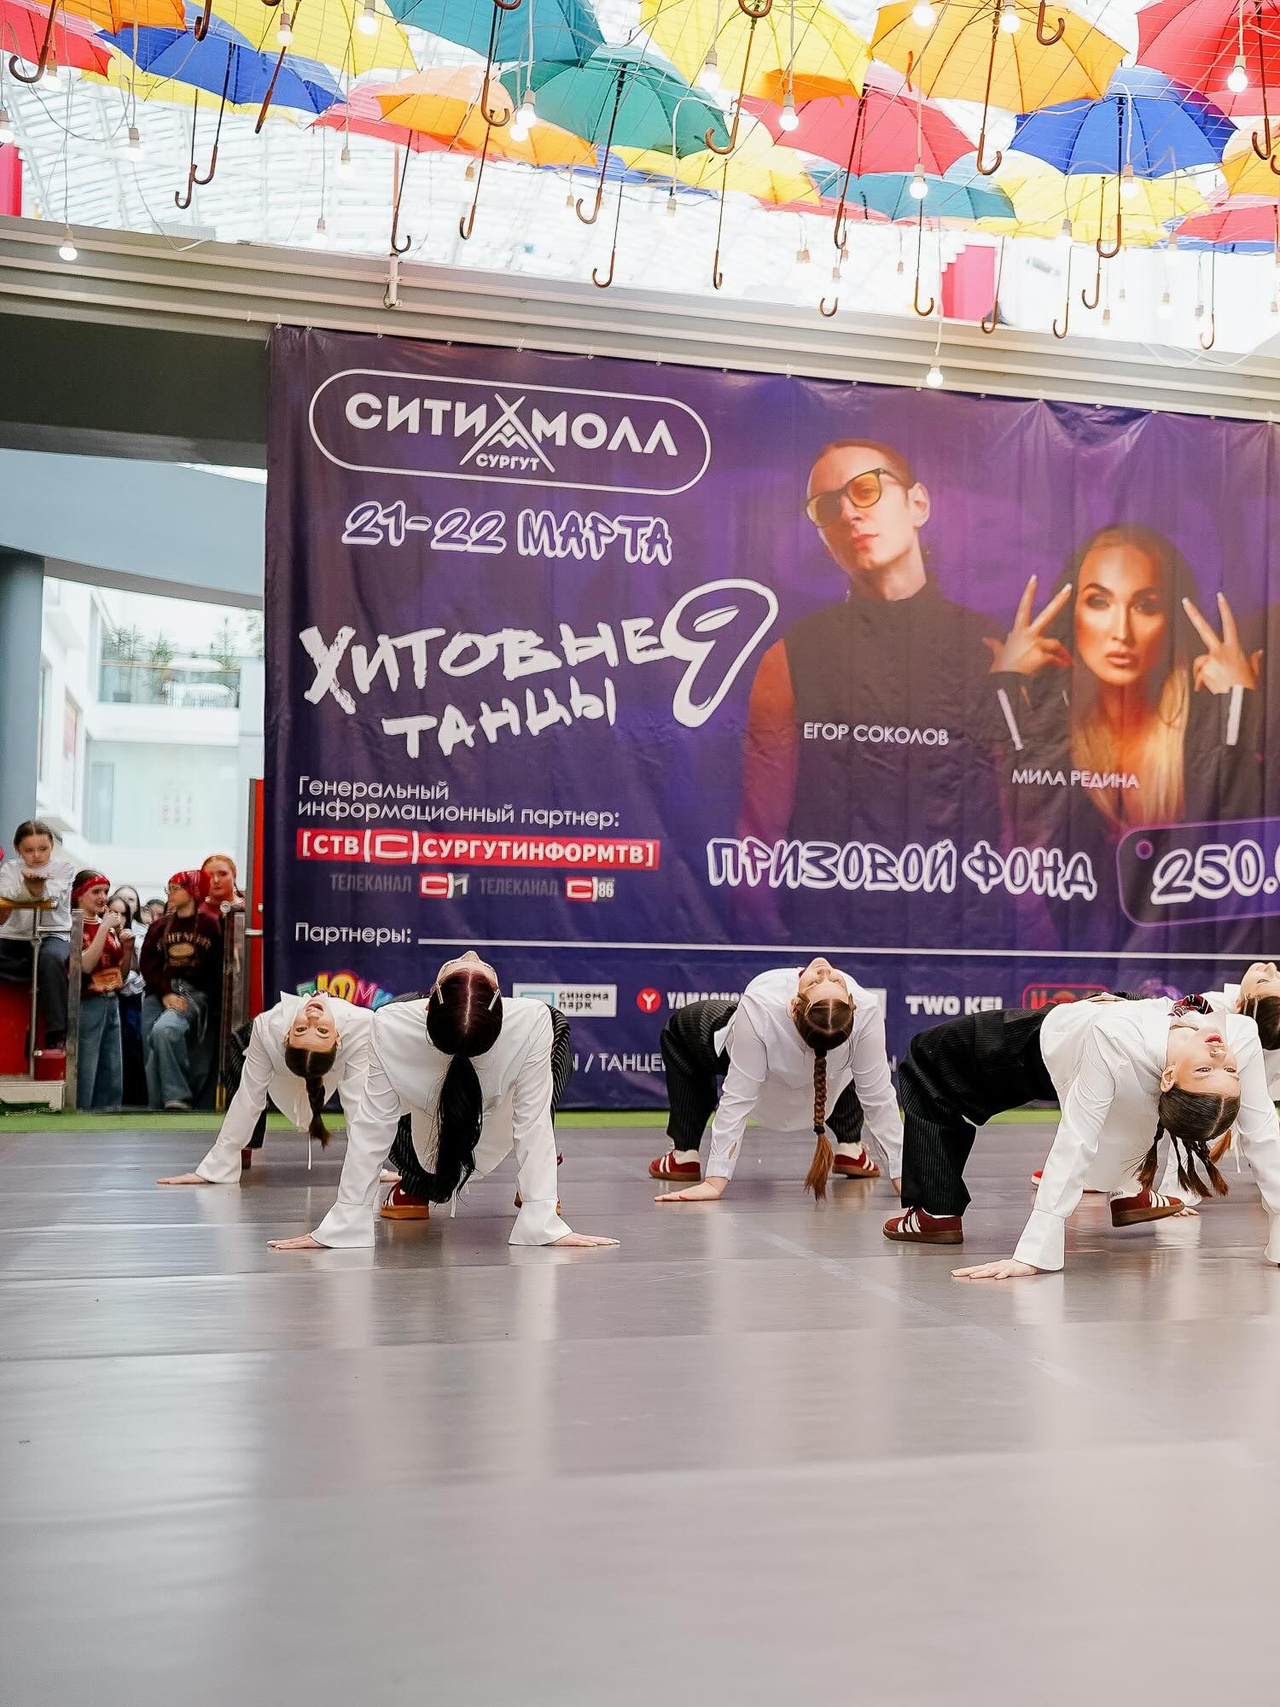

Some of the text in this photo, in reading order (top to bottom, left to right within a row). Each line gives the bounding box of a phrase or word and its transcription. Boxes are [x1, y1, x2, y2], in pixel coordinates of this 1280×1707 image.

[344, 392, 678, 456] СИТИ МОЛЛ
[475, 454, 540, 472] СУРГУТ
[341, 500, 673, 566] 21-22 МАРТА
[381, 676, 617, 759] ТАНЦЫ
[803, 722, 950, 746] ЕГОР СОКОЛОВ
[299, 776, 449, 799] Генеральный
[1011, 769, 1141, 790] МИЛА РЕДИНА
[299, 799, 620, 829] информационный партнер:
[706, 836, 1099, 901] ПРИЗОВОЙ ФОНД
[330, 873, 412, 893] ТЕЛЕКАНАЛ
[480, 877, 559, 896] ТЕЛЕКАНАЛ
[295, 922, 412, 946] Партнеры:
[559, 1001, 592, 1012] парк
[904, 995, 960, 1016] TWO
[599, 1053, 666, 1074] ТАНЦЕ
